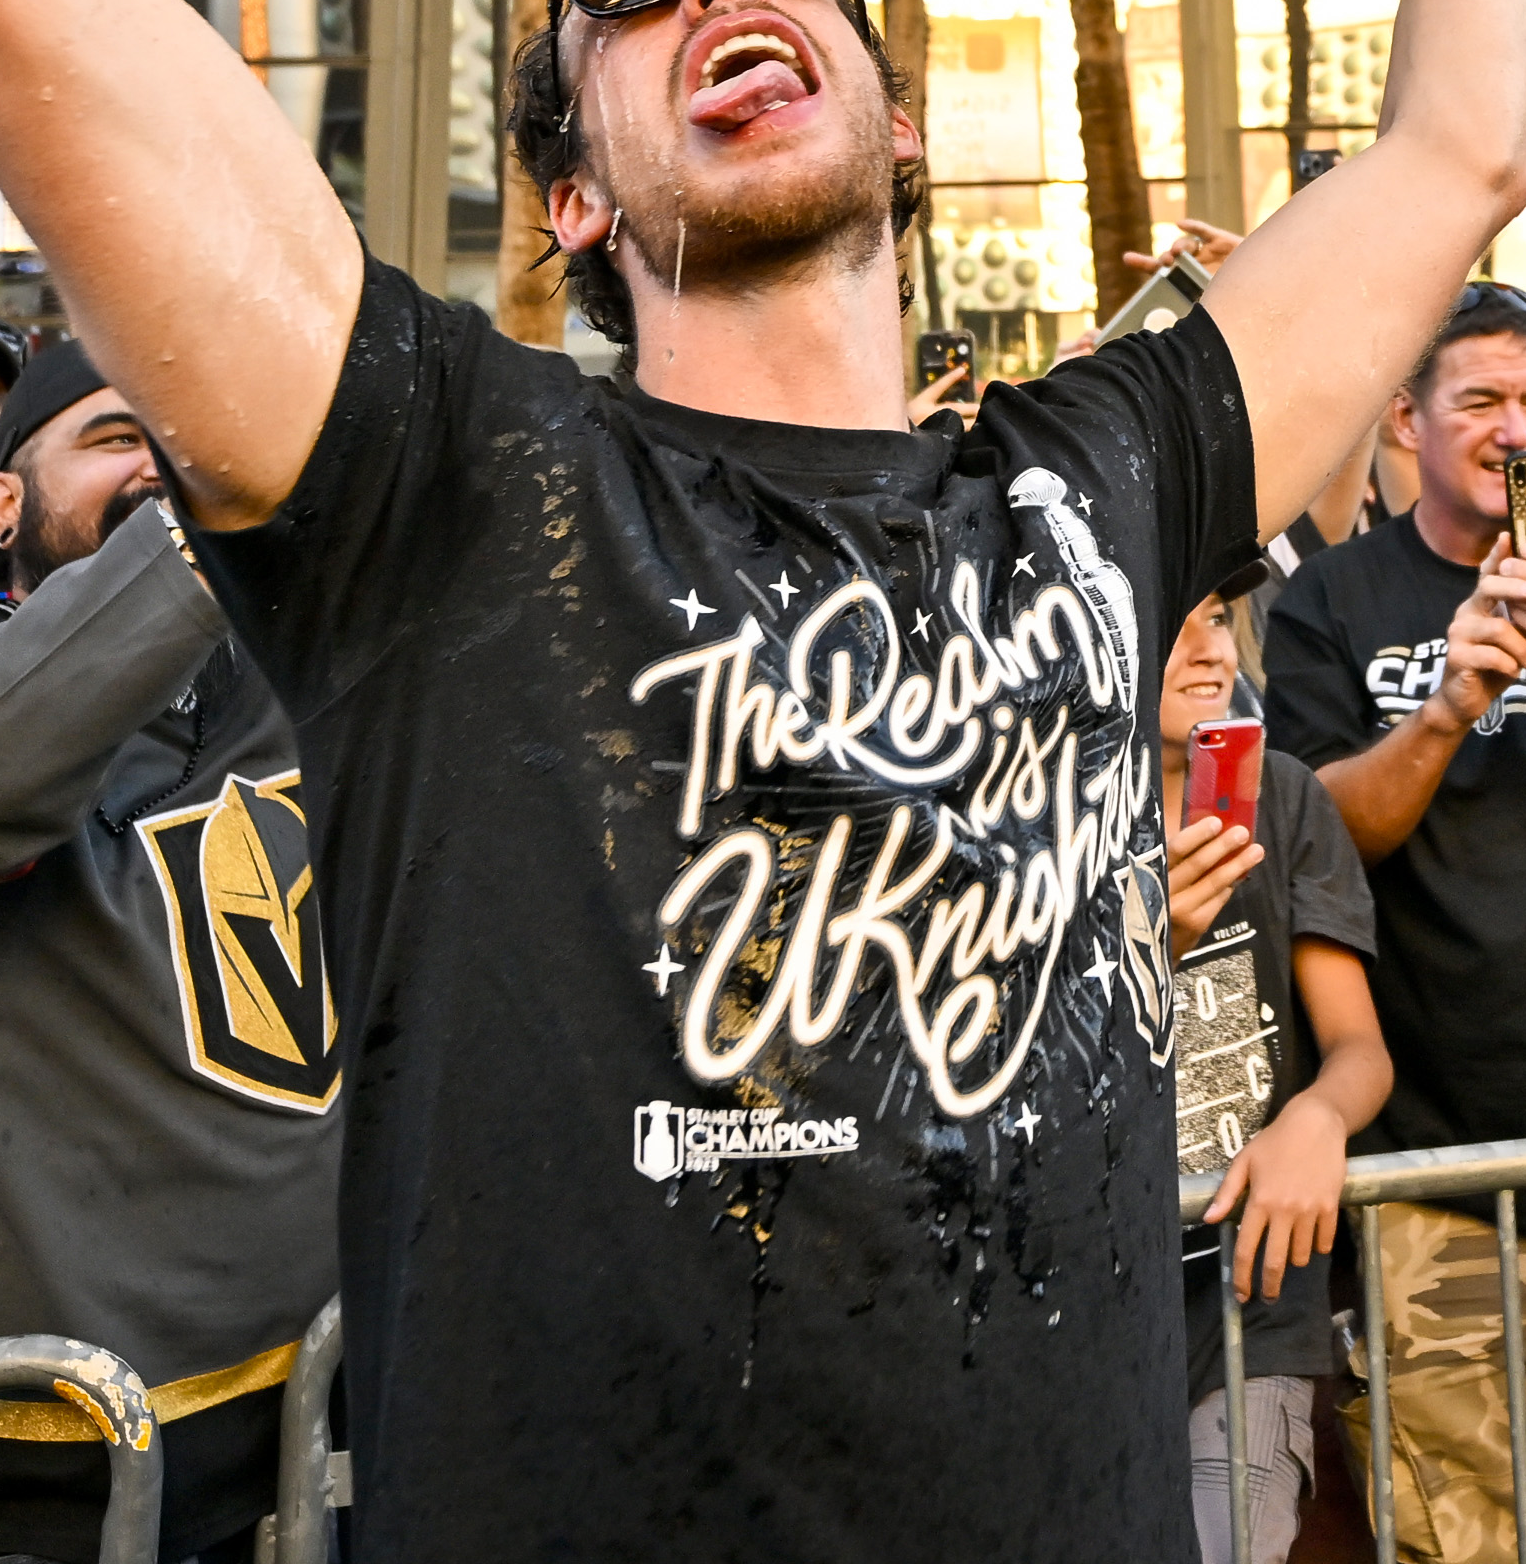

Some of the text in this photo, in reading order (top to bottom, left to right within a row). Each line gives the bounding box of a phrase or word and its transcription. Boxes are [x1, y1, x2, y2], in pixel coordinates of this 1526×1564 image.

[631, 559, 1115, 837] The Realm
[685, 1115, 860, 1152] CHAMPIONS
[686, 1107, 785, 1127] STANLEY CUP
